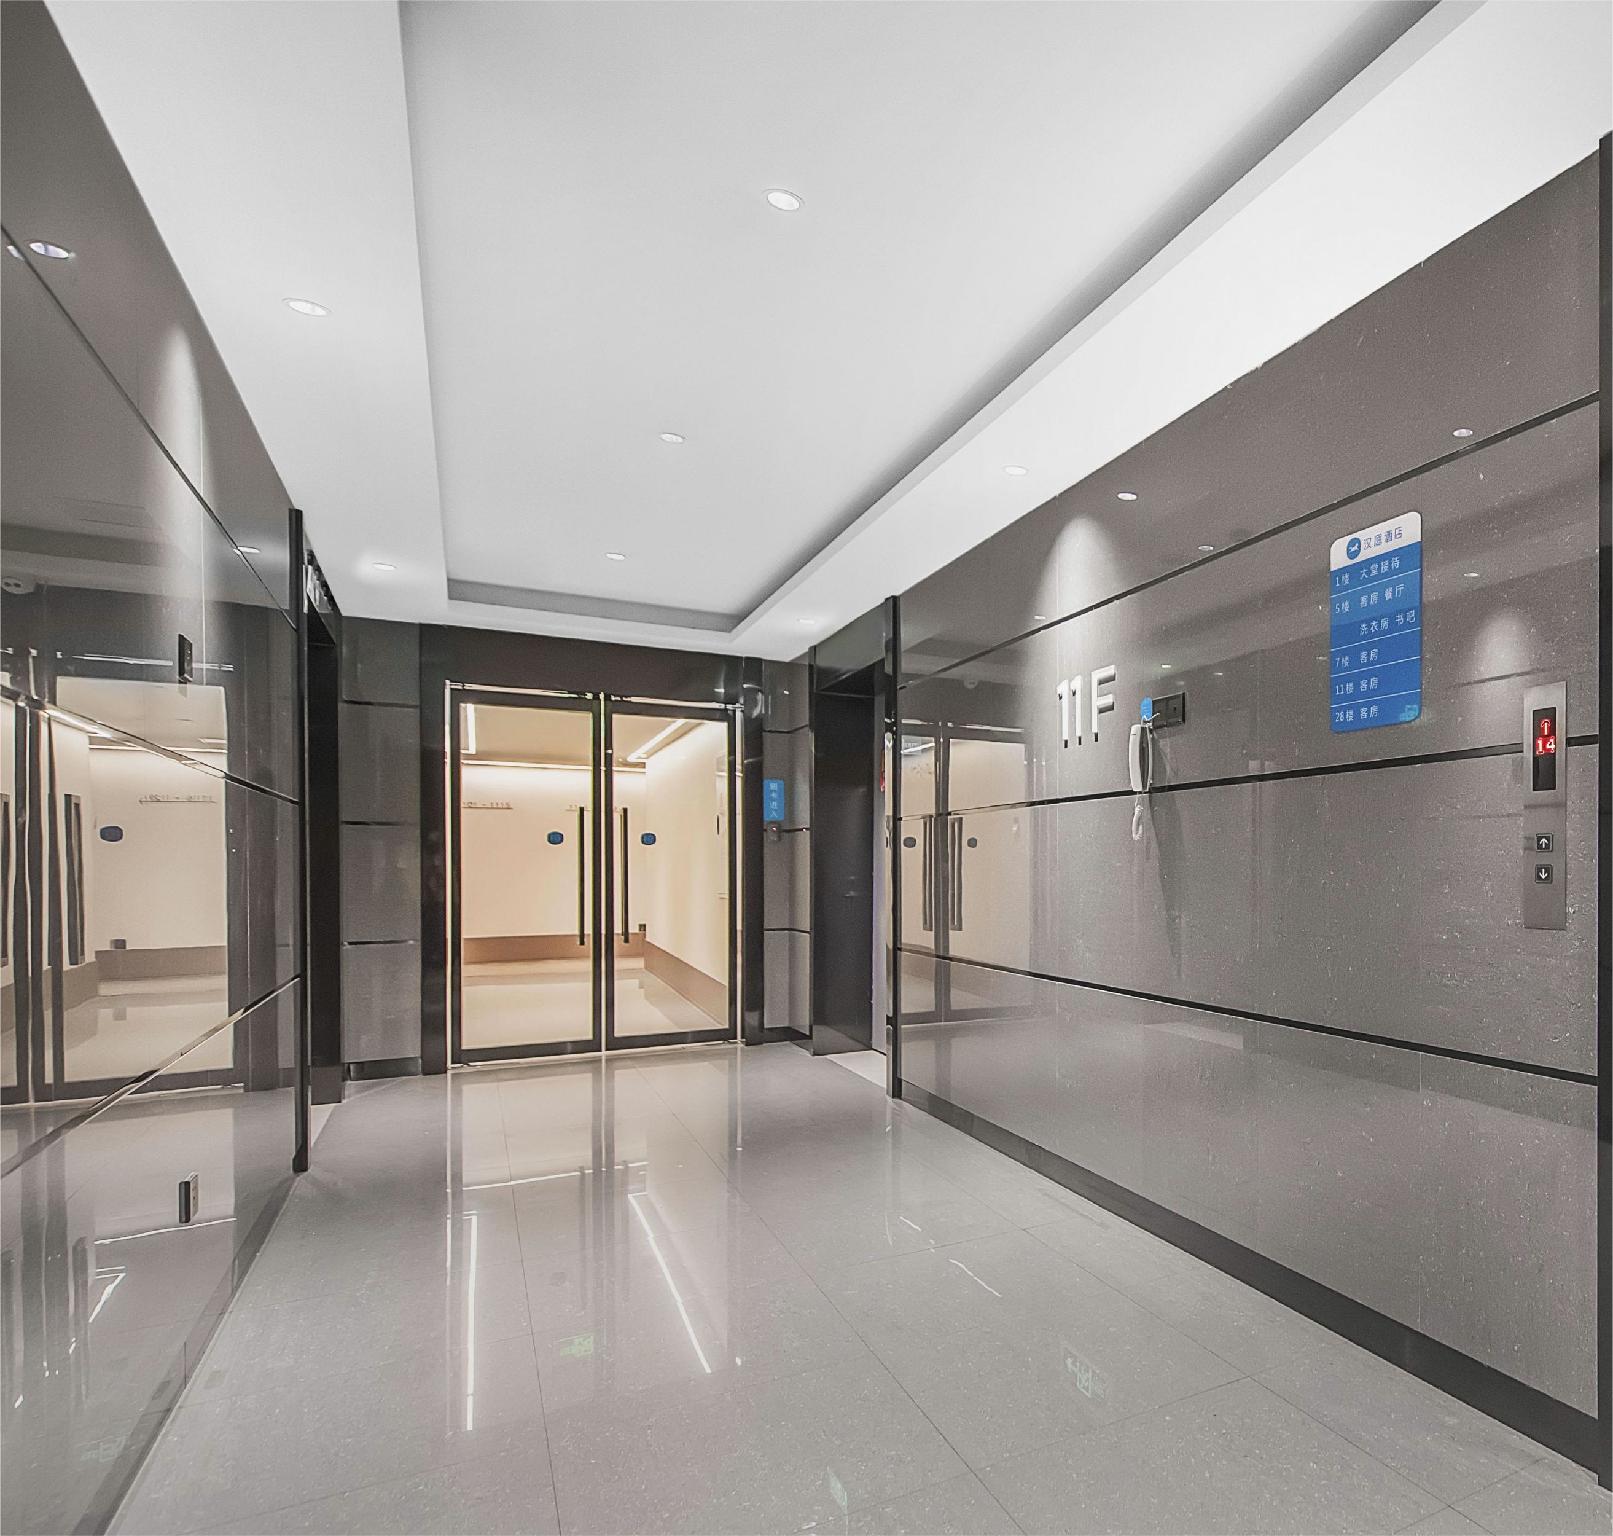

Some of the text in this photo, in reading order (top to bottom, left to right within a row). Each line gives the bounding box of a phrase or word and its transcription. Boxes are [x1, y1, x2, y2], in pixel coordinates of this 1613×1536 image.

[1335, 557, 1400, 587] 1楼 大堂接待
[1335, 584, 1405, 614] 5楼 客房 餐厅
[1360, 610, 1416, 635] 洗衣房 书吧
[1335, 649, 1379, 667] 7楼 客房
[1335, 677, 1378, 695] 11楼 客房
[1056, 664, 1116, 747] 11F
[1335, 705, 1378, 722] 28楼 客房
[1535, 736, 1556, 755] 14
